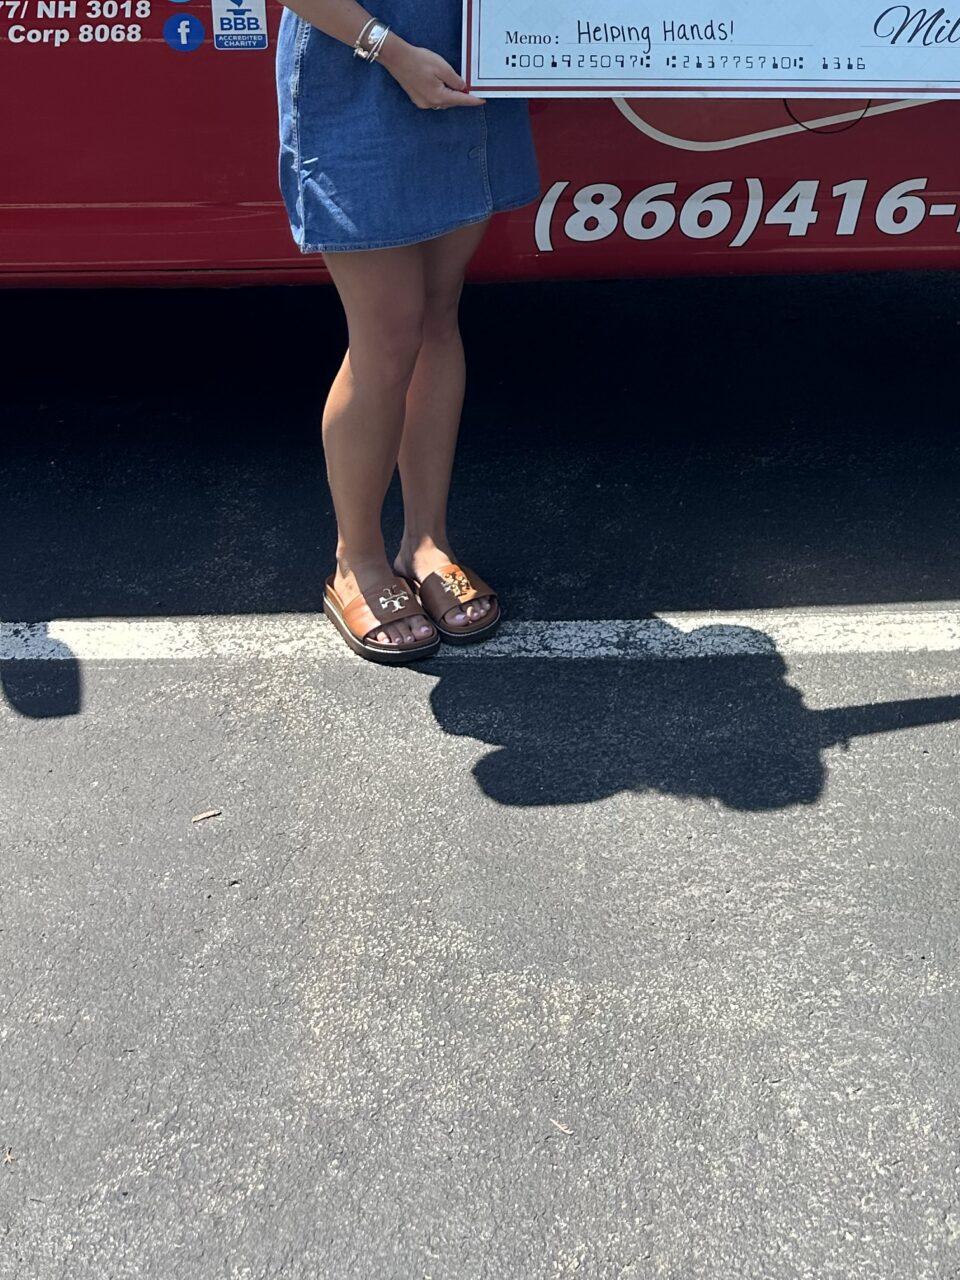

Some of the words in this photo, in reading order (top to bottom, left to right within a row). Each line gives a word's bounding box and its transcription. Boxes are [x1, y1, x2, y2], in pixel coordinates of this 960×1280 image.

[37, 0, 77, 18] NH
[86, 0, 151, 19] 3018
[8, 25, 70, 47] Corp
[78, 25, 142, 43] 8068
[505, 32, 559, 45] Memo:
[577, 20, 651, 54] Helping
[663, 20, 734, 42] Hands!
